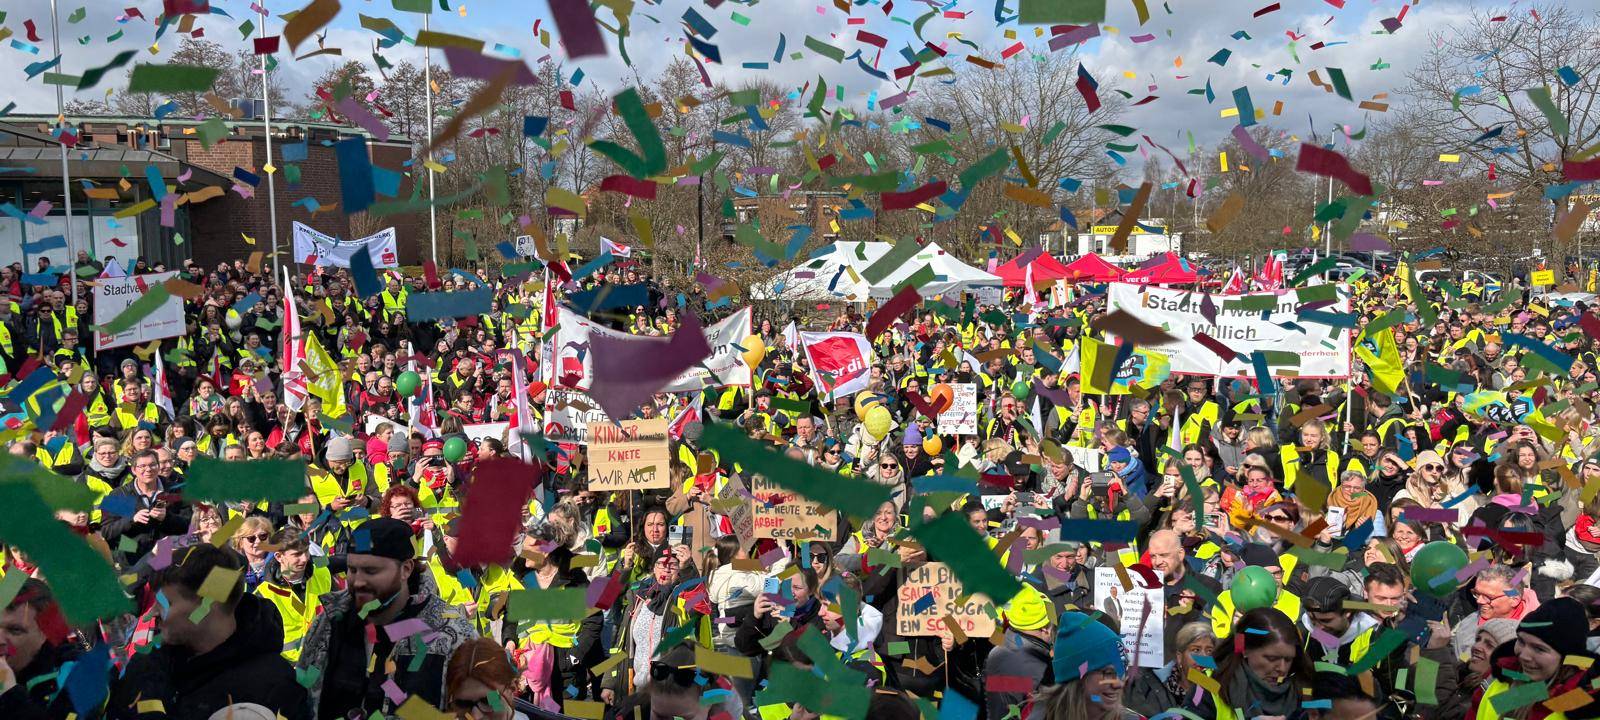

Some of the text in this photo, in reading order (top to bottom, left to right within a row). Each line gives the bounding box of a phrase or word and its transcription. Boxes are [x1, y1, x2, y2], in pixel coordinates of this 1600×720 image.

[1191, 322, 1258, 341] Willich
[594, 425, 638, 445] KINDER
[608, 449, 641, 462] KNETE
[597, 467, 656, 486] WIR AUCH
[775, 504, 800, 515] HEUTE
[754, 517, 785, 529] ARBEIT
[901, 620, 921, 634] EIN
